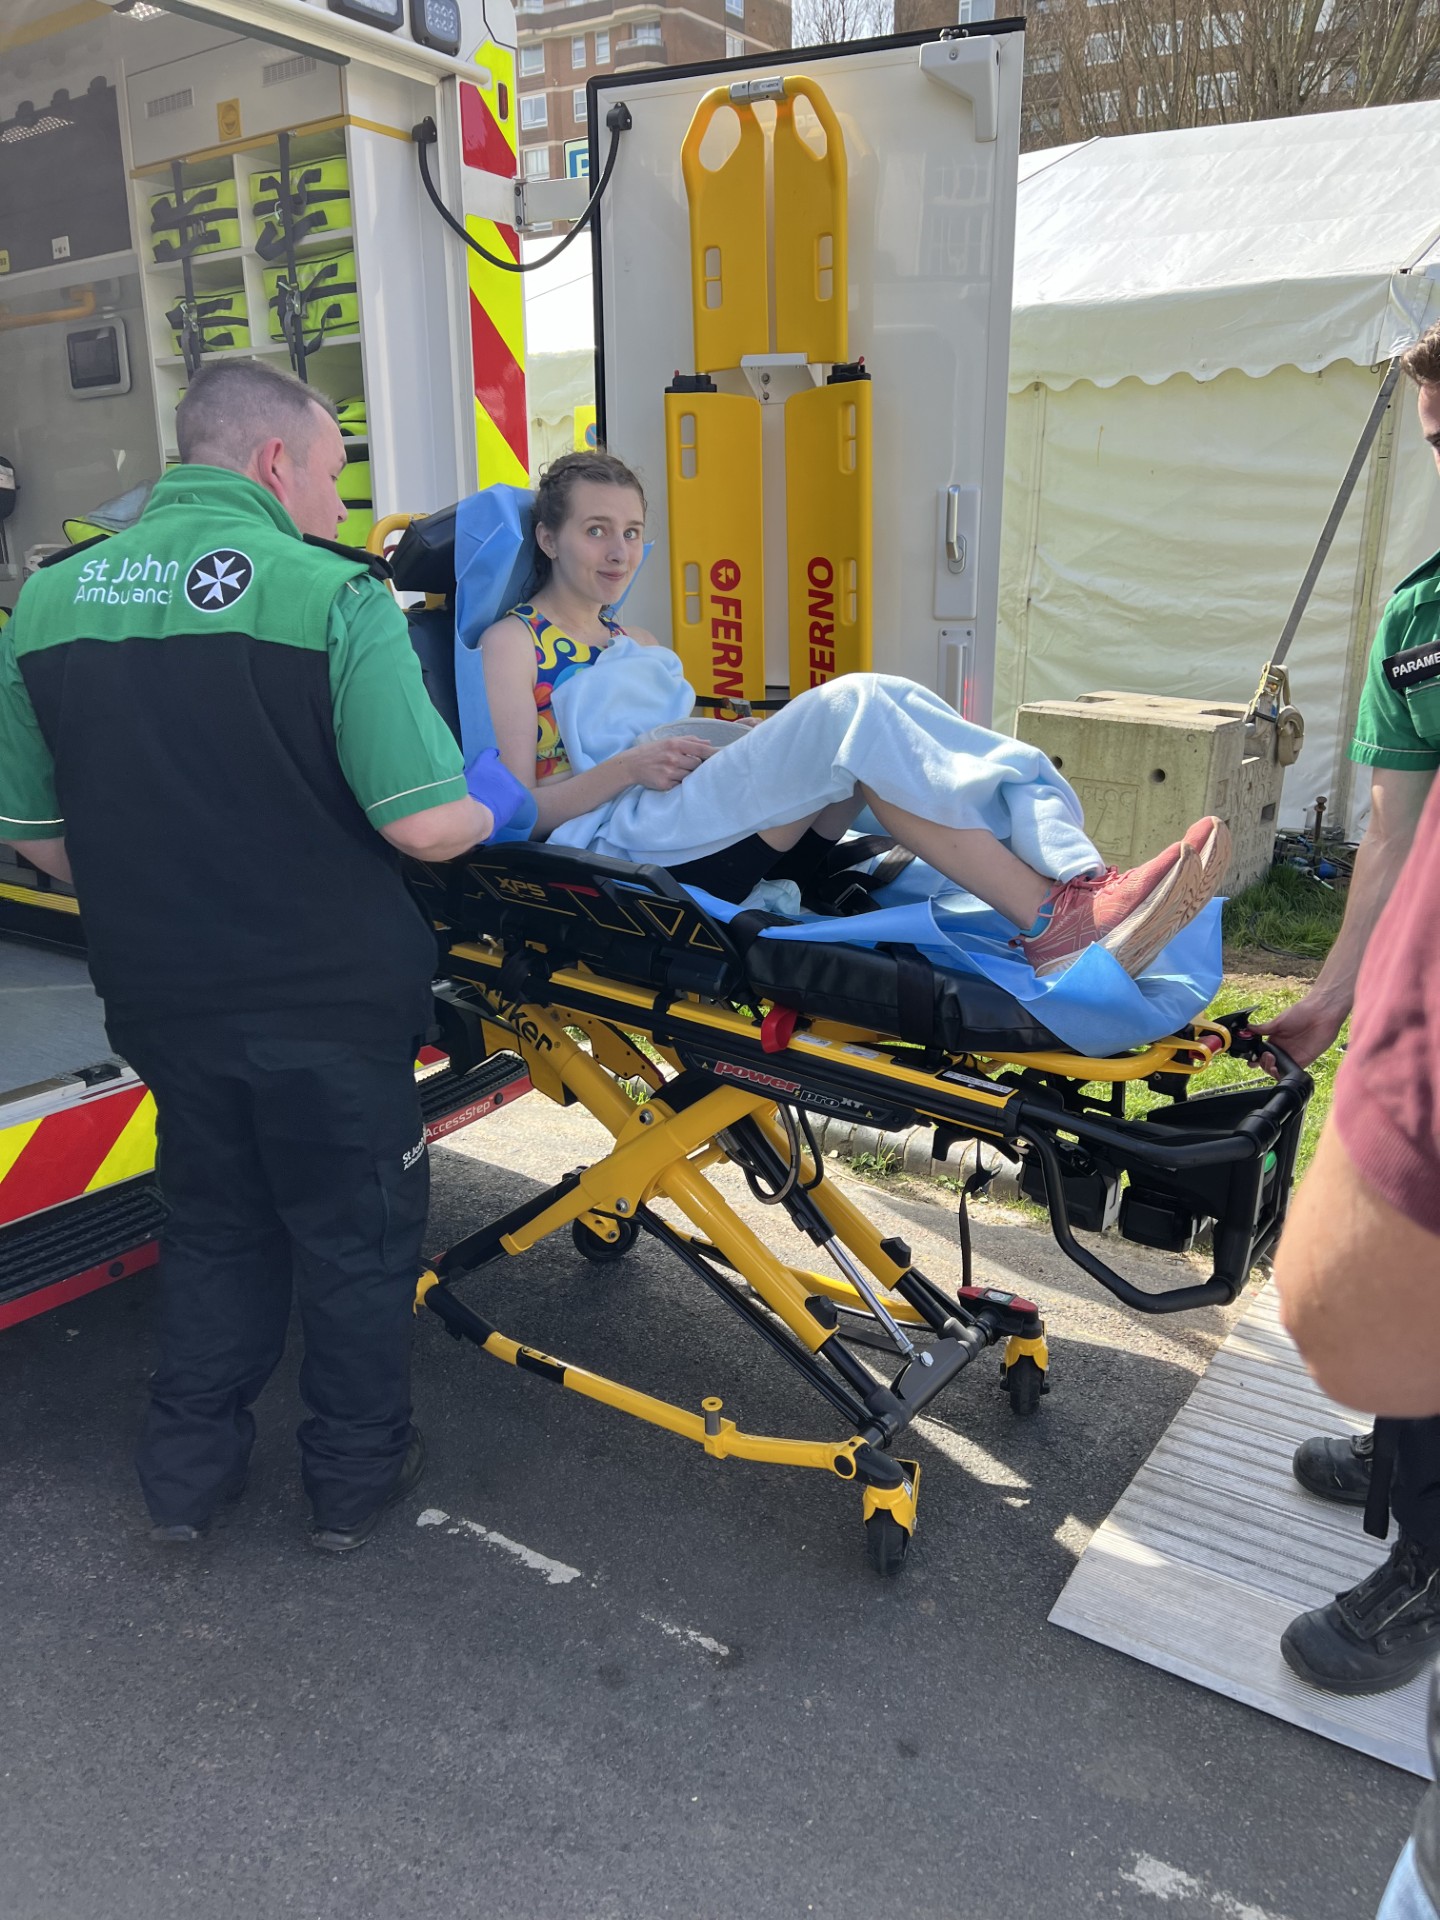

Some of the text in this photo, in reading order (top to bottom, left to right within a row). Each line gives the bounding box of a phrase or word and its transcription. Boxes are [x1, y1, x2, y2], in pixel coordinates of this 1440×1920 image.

[78, 553, 179, 584] St John
[494, 876, 546, 897] XPS
[714, 1060, 801, 1093] power
[800, 1089, 840, 1108] pro
